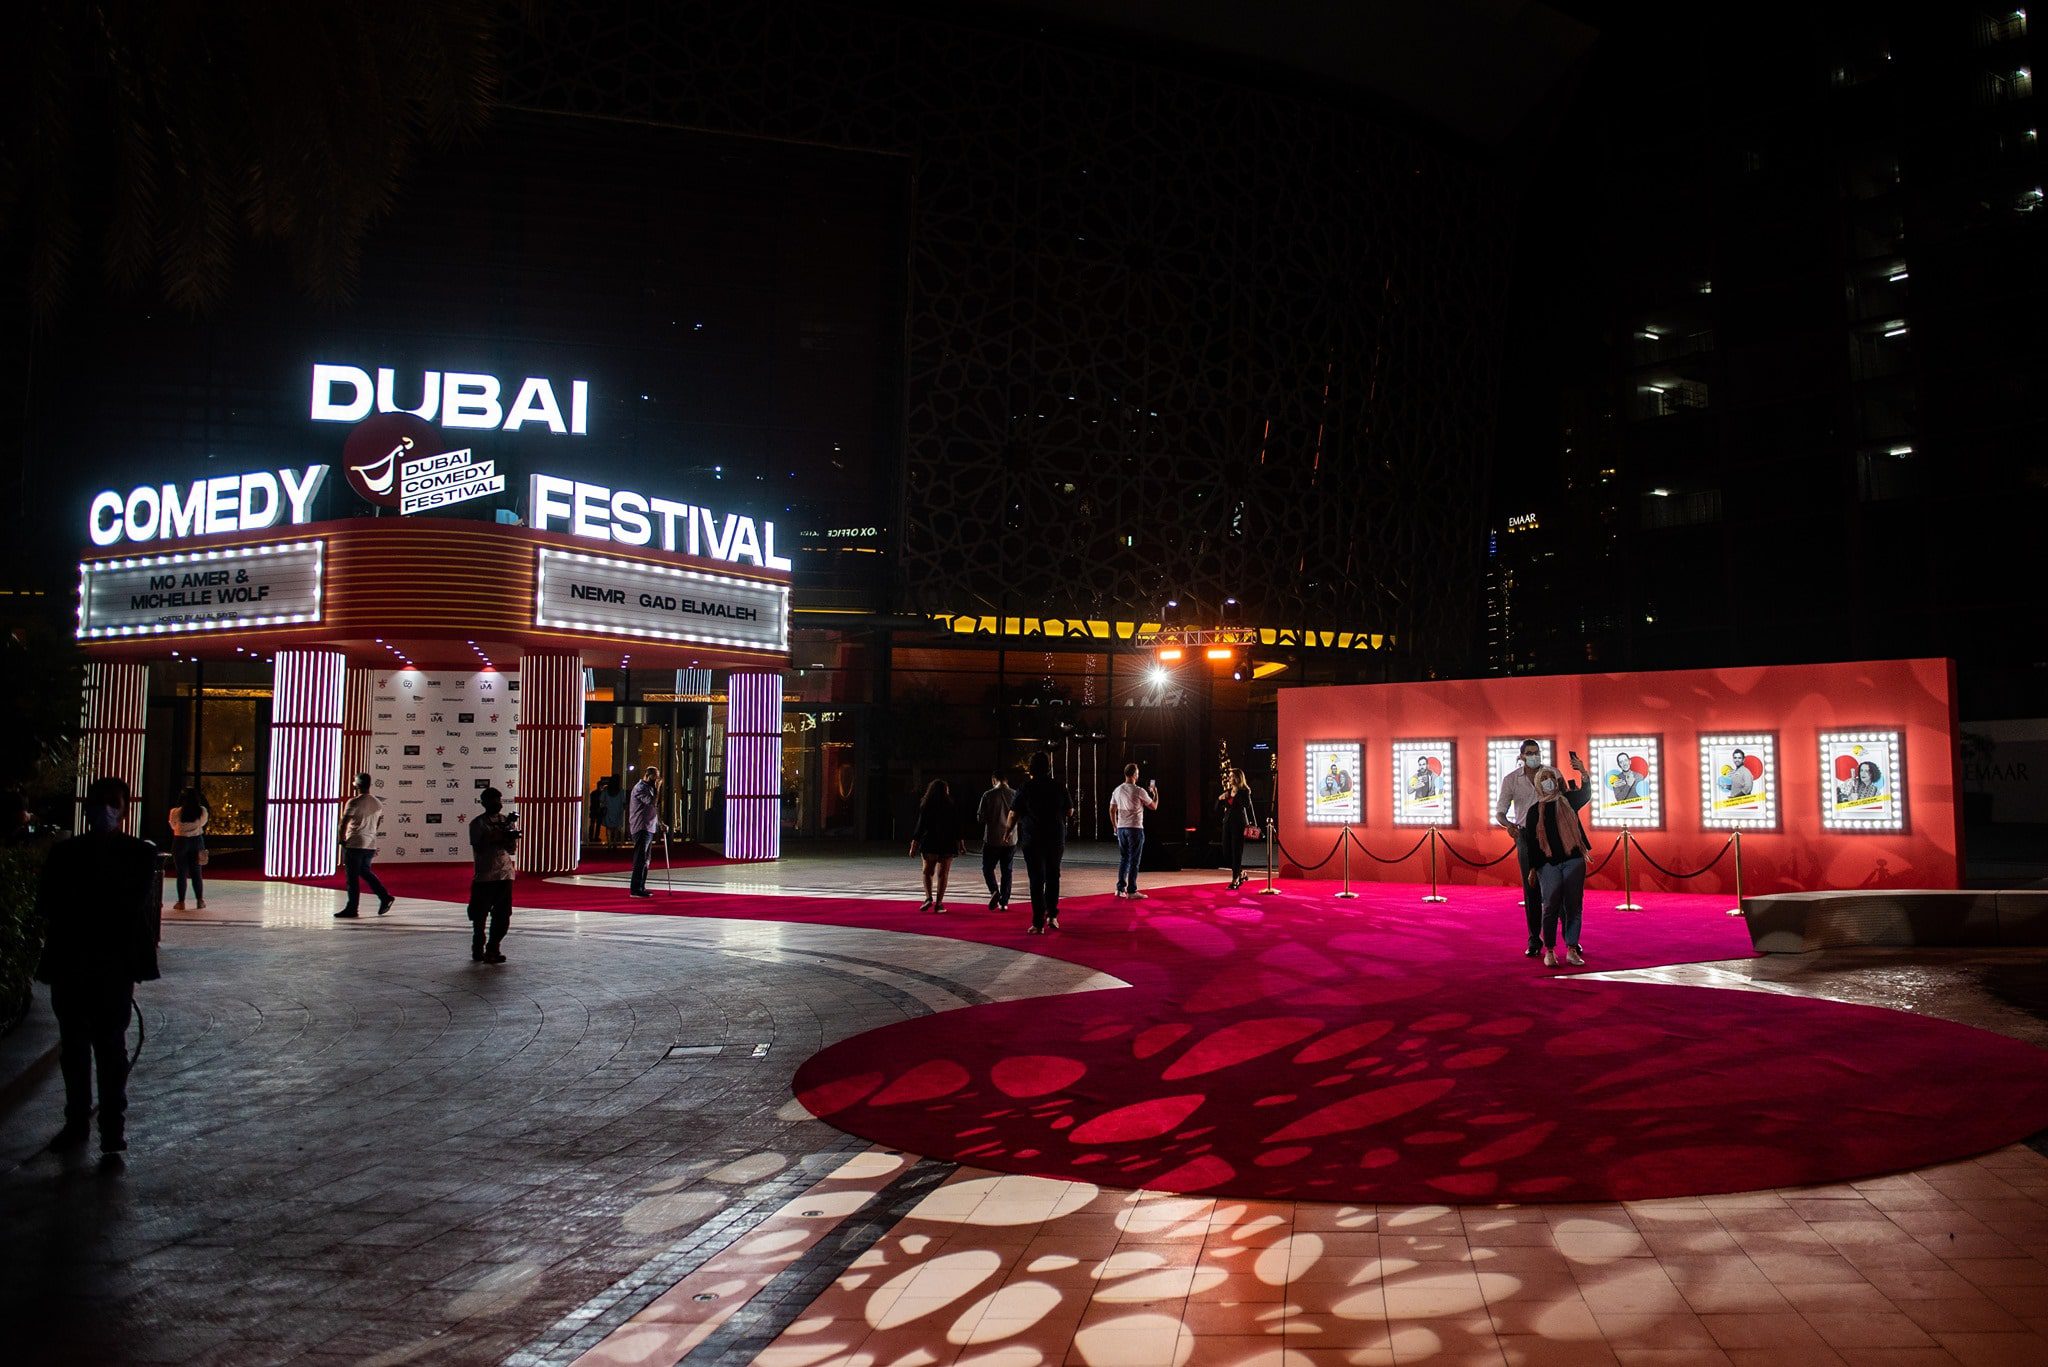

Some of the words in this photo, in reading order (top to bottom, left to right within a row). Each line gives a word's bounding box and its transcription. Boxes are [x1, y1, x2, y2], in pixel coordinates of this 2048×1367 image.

[311, 363, 588, 435] DUBAI
[405, 452, 468, 476] DUBAI
[405, 464, 491, 493] COMEDY
[89, 464, 330, 547] COMEDY
[404, 480, 501, 512] FESTIVAL
[530, 473, 792, 571] FESTIVAL
[1508, 513, 1537, 527] EMAAR
[150, 574, 176, 591] MO
[182, 570, 229, 589] AMER
[235, 568, 249, 584] &
[131, 590, 211, 609] MICHELLE
[217, 586, 269, 604] WOLF
[571, 584, 625, 604] NEMR
[639, 594, 677, 611] GAD
[682, 599, 757, 621] ELMALEH
